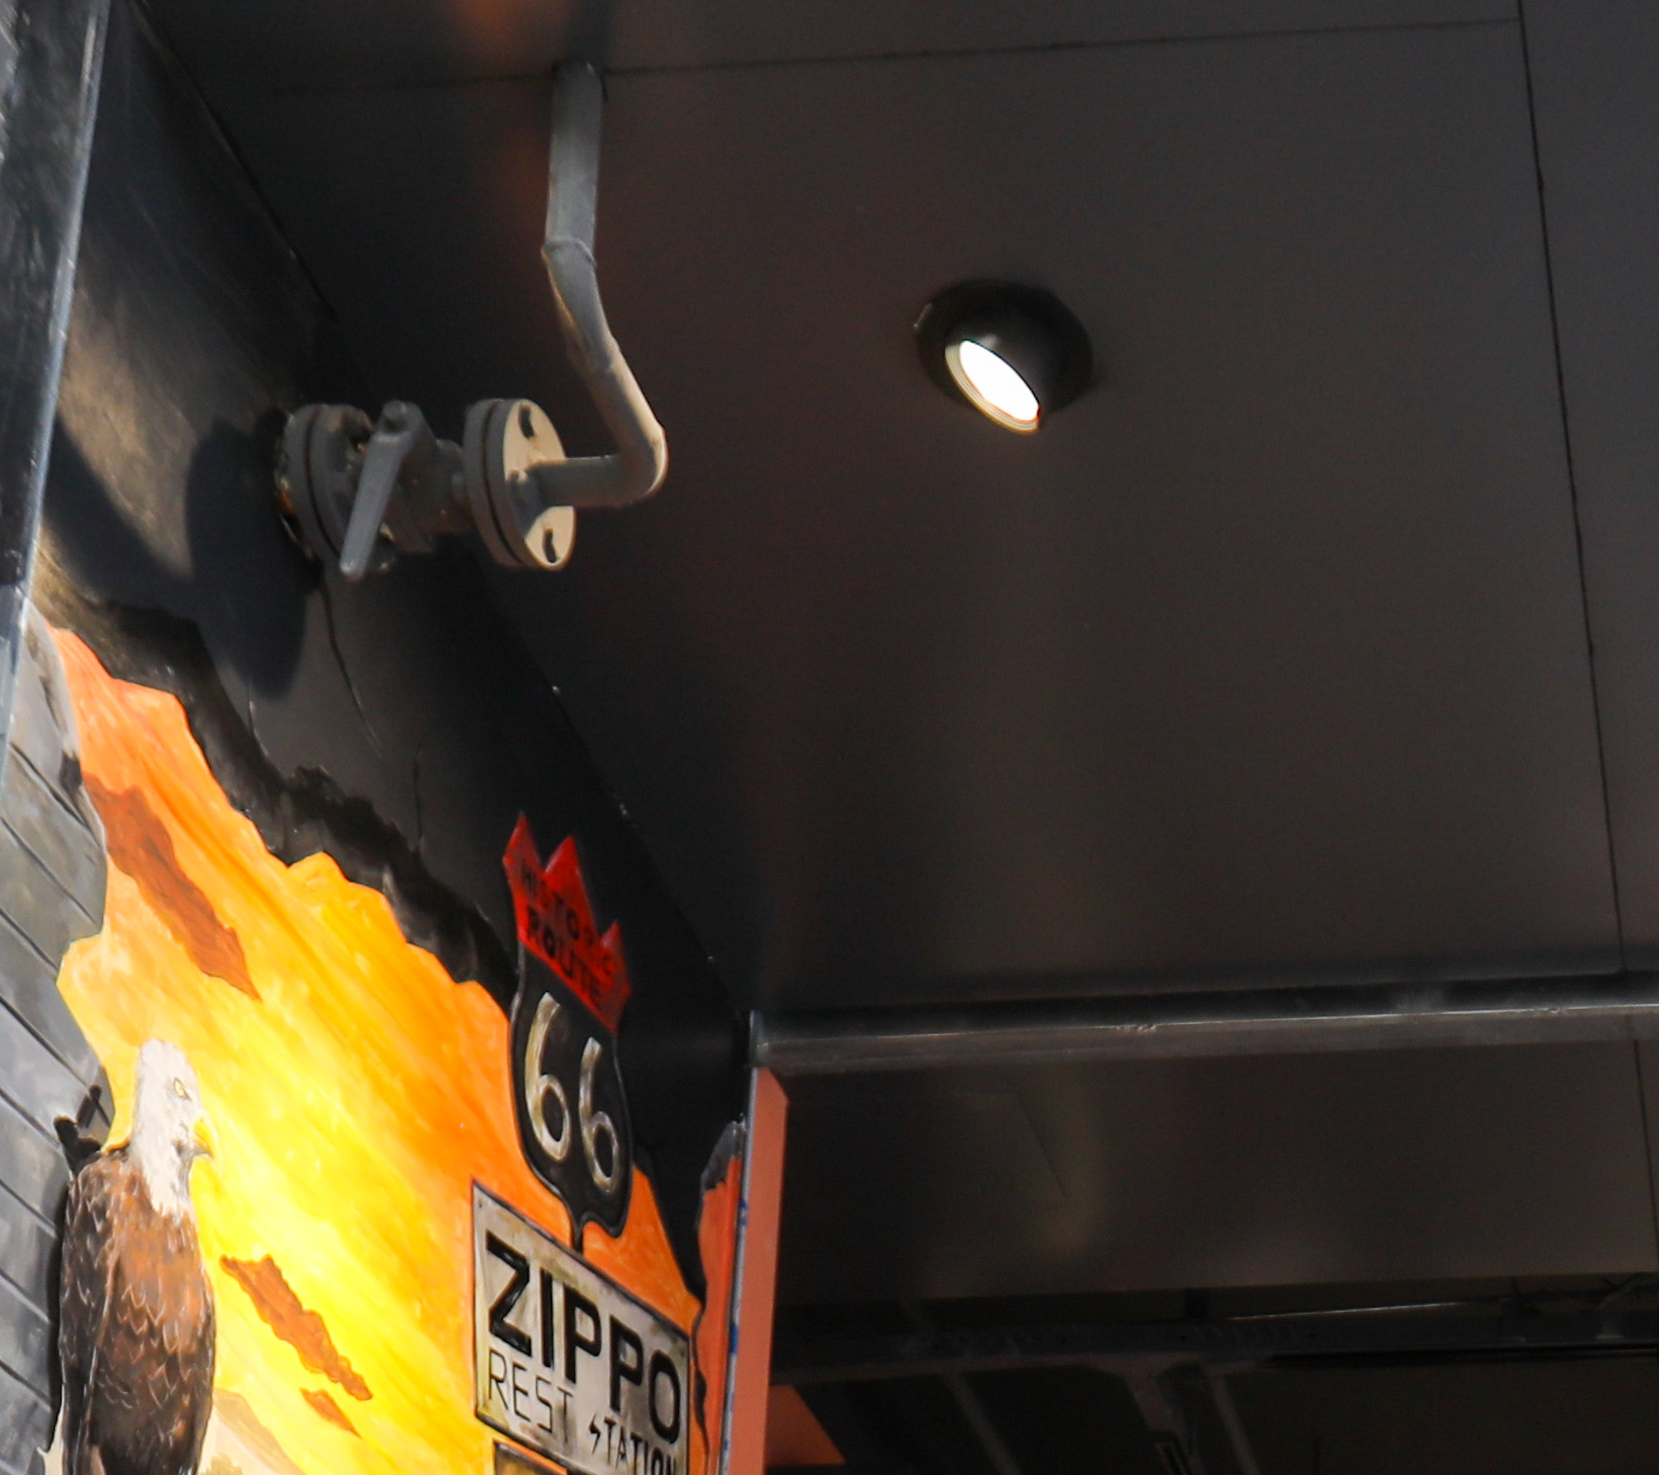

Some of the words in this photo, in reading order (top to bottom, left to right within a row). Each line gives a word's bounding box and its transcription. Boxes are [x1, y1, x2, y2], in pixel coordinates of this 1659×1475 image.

[524, 990, 621, 1194] 66
[485, 1228, 681, 1446] ZIPPO
[488, 1346, 574, 1444] REST
